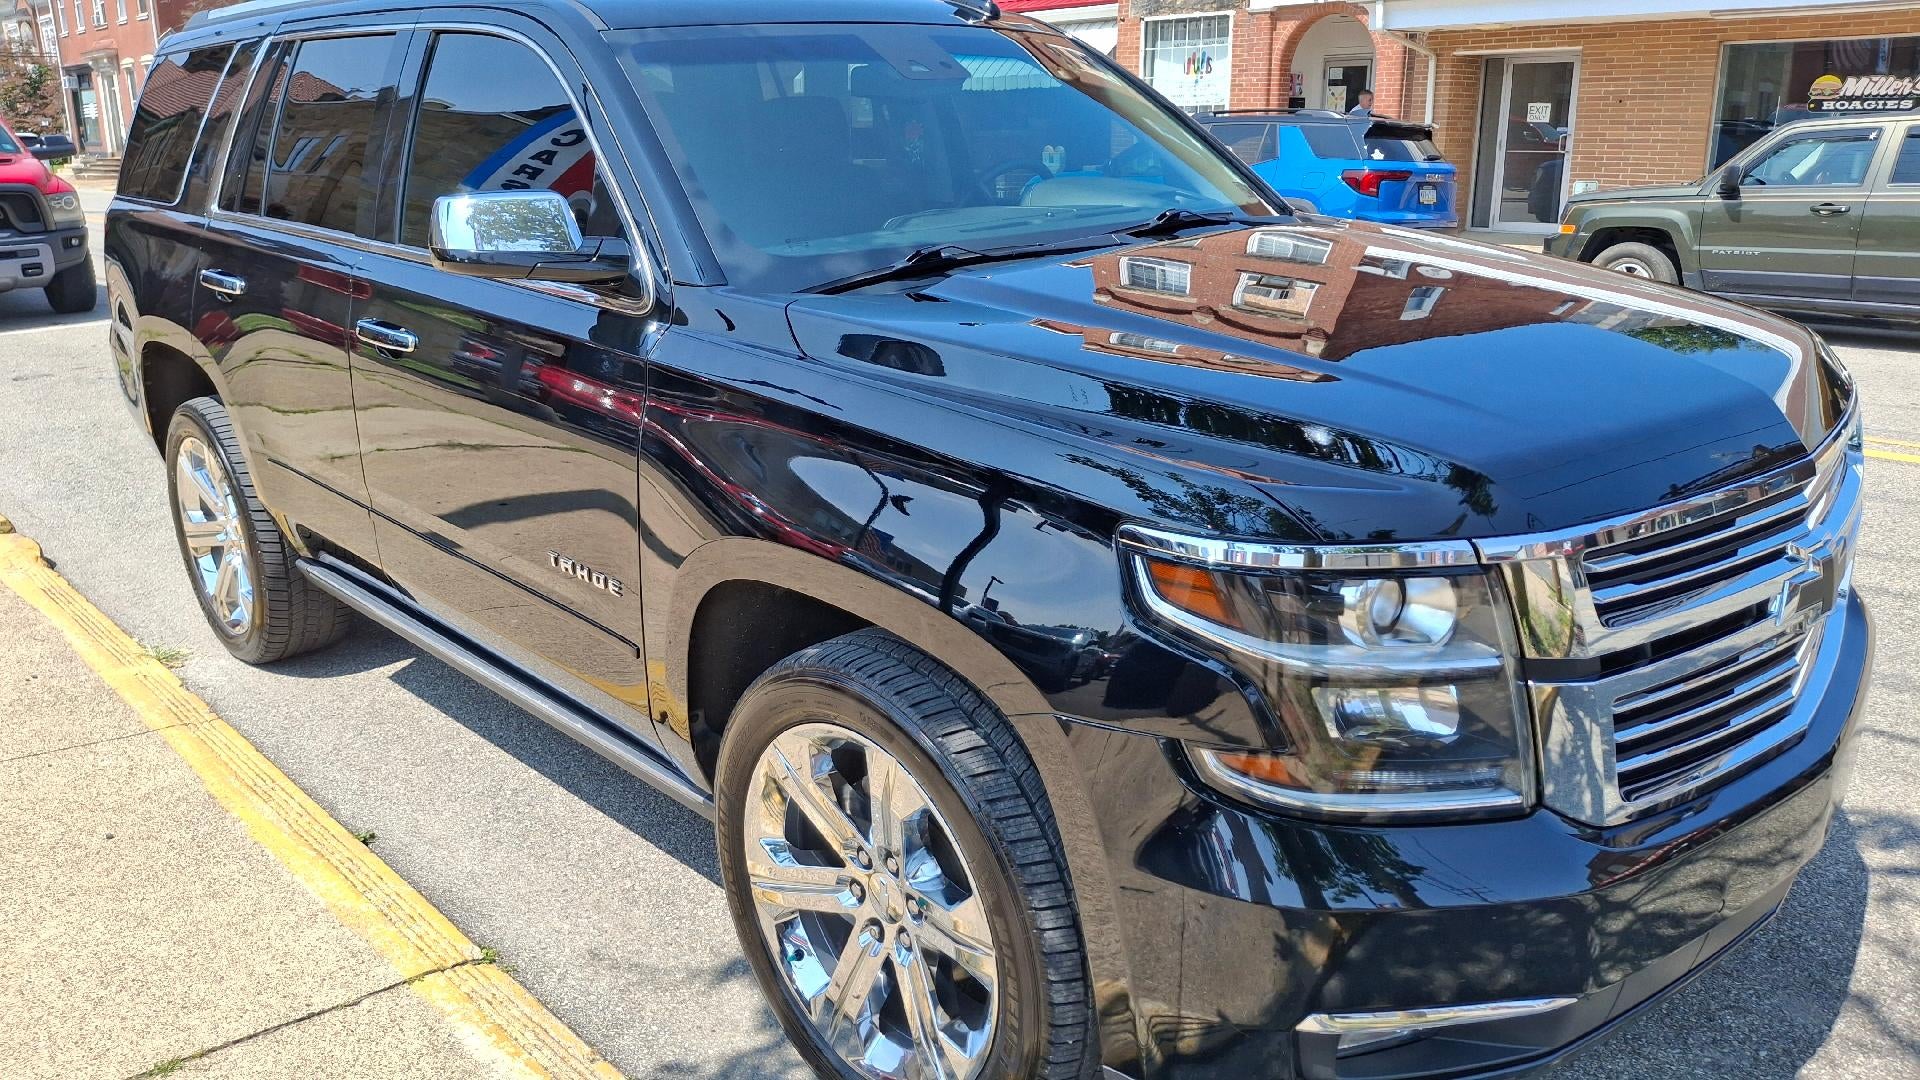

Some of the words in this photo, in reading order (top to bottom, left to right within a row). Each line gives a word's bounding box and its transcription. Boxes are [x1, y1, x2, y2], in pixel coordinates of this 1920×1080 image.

[1529, 105, 1549, 115] EXIT
[1821, 100, 1913, 110] HOAGIES
[547, 549, 624, 598] TAHOE
